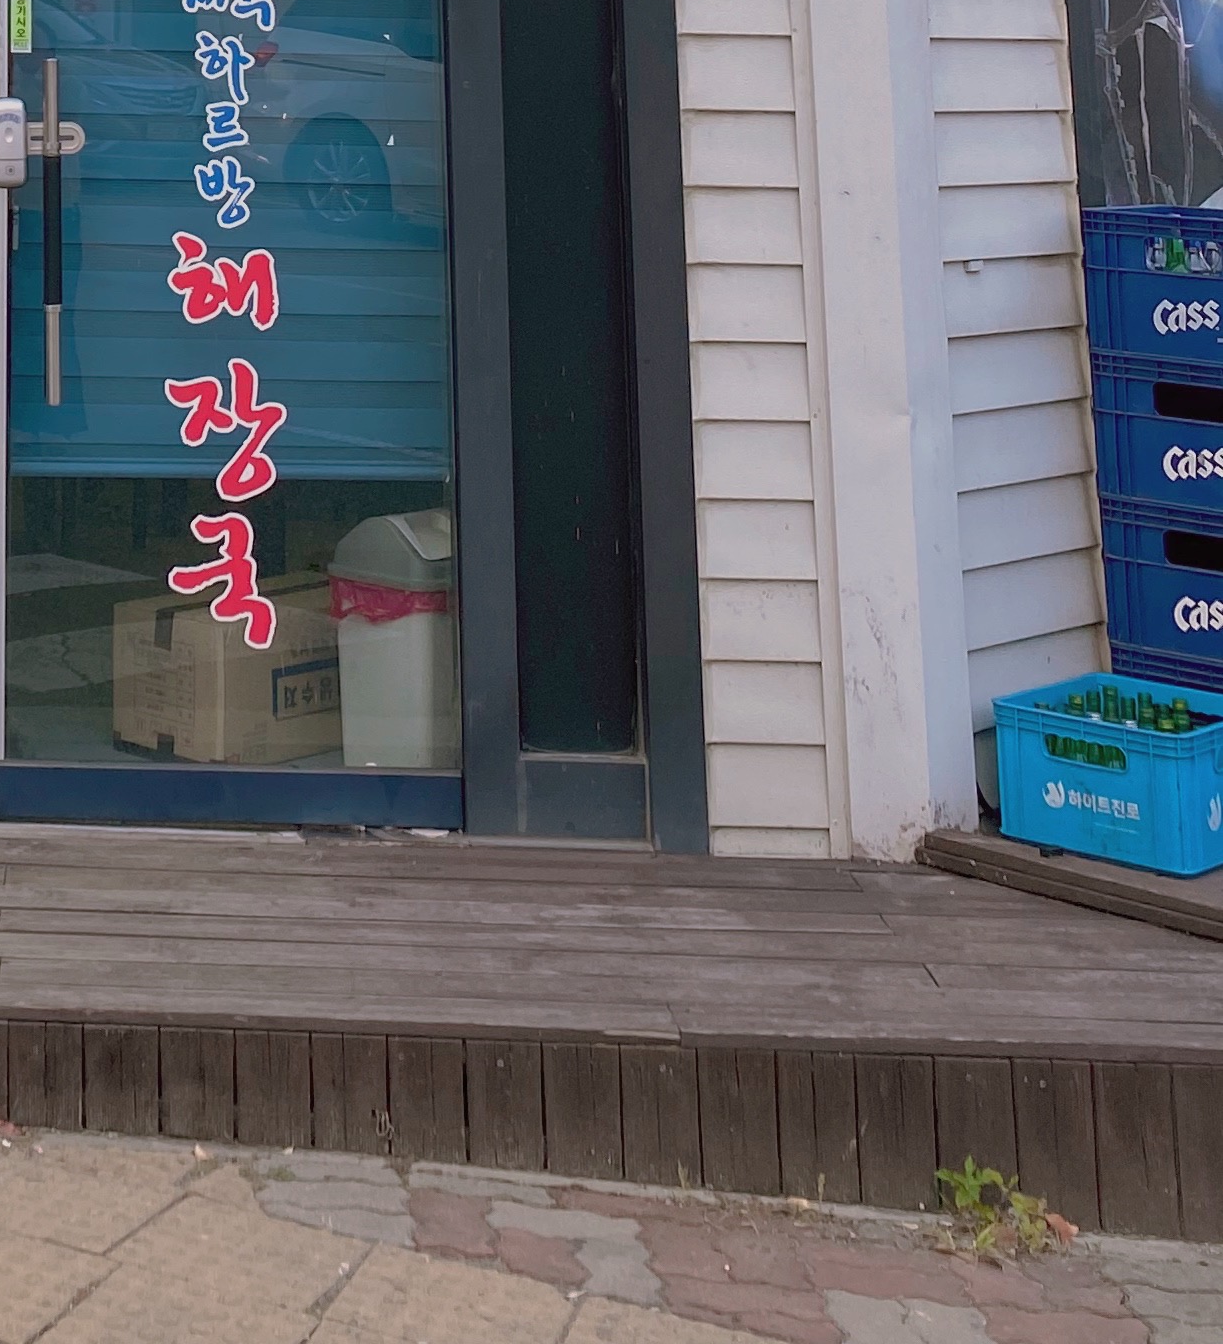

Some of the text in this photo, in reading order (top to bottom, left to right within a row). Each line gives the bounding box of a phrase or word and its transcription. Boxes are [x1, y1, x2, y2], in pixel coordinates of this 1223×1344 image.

[198, 34, 252, 224] 하르방
[1153, 299, 1220, 335] Cass
[169, 235, 284, 644] 해장국
[1068, 789, 1141, 821] 하이트진로
